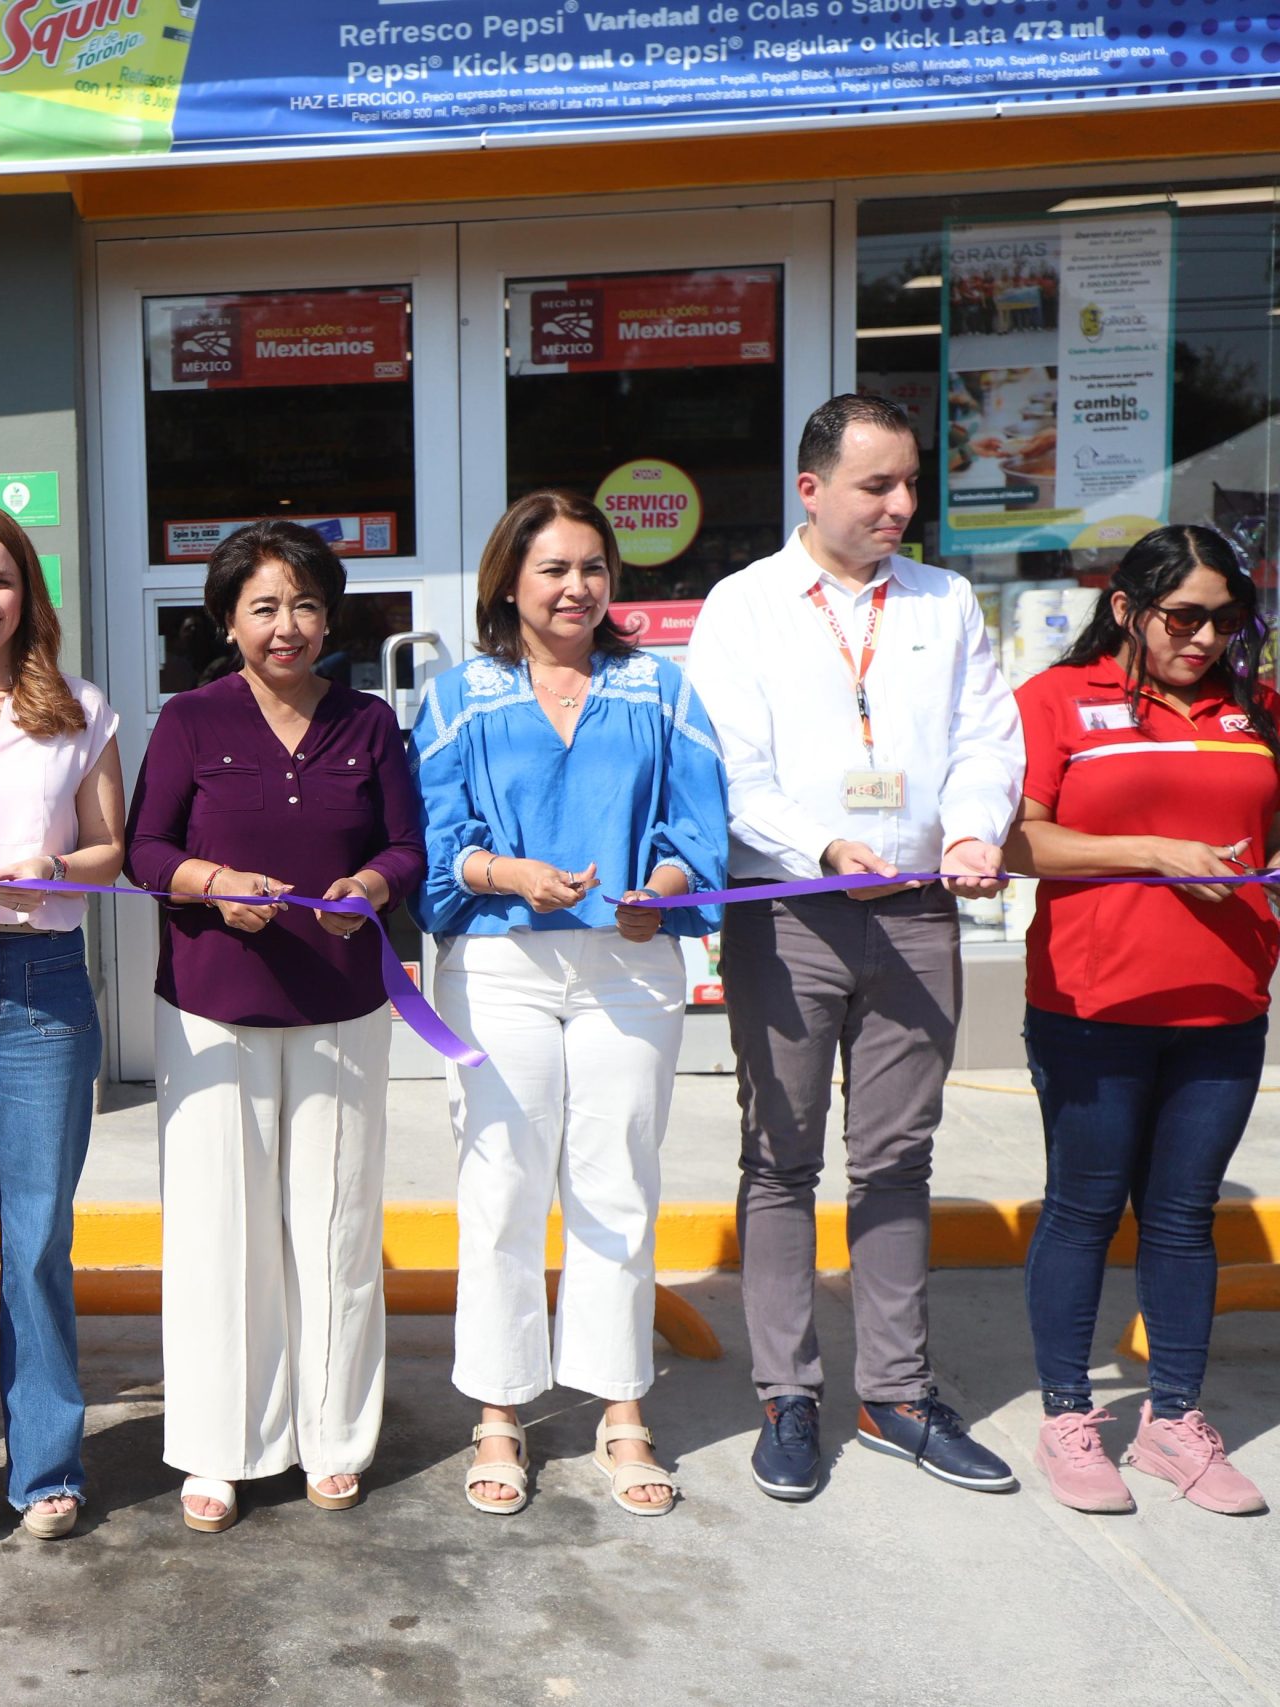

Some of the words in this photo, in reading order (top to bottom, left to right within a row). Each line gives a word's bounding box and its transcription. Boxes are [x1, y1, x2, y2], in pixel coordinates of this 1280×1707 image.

[339, 20, 472, 48] Refresco
[584, 5, 701, 32] Variedad
[708, 3, 739, 24] de
[747, 0, 819, 22] Colas
[827, 0, 843, 16] o
[76, 33, 140, 69] Toronja
[453, 50, 519, 78] Kick
[524, 52, 574, 74] 500
[579, 48, 615, 71] ml
[619, 52, 635, 68] o
[753, 35, 852, 62] Regular
[860, 36, 876, 51] o
[885, 27, 941, 50] Kick
[949, 25, 1006, 47] Lata
[1014, 20, 1064, 42] 473
[1070, 16, 1105, 38] ml
[120, 66, 166, 88] Refresco
[289, 95, 324, 111] HAZ
[327, 90, 420, 109] EJERCICIO.
[422, 91, 454, 103] Precio
[455, 88, 508, 103] expresado
[509, 89, 523, 98] en
[524, 86, 565, 97] moneda
[612, 80, 651, 93] Marcas
[835, 64, 889, 79] Manzanita
[1050, 56, 1056, 64] y
[1059, 50, 1091, 64] Squirt
[75, 79, 101, 94] con
[352, 110, 380, 123] Pepsi
[413, 107, 433, 119] 500
[489, 105, 497, 114] o
[498, 101, 527, 115] Pepsi
[560, 98, 582, 110] Lata
[584, 97, 604, 109] 473
[623, 95, 642, 107] Las
[644, 93, 693, 107] imágenes
[695, 89, 748, 102] mostradas
[749, 88, 769, 98] son
[771, 86, 784, 97] de
[841, 79, 870, 94] Pepsi
[893, 77, 924, 90] Globo
[926, 76, 940, 88] de
[942, 73, 973, 86] Pepsi
[975, 72, 995, 84] son
[996, 69, 1034, 82] Marcas
[950, 242, 1048, 265] GRACIAS
[541, 299, 576, 309] HECHO
[580, 298, 594, 307] EN
[181, 317, 214, 327] HECHO
[218, 317, 231, 326] EN
[618, 319, 742, 340] Mexicanos
[256, 338, 375, 359] Mexicanos
[541, 342, 593, 356] MÉXICO
[182, 360, 232, 373] MÉXICO
[376, 364, 402, 375] OXXO
[1074, 394, 1138, 410] cambio
[1073, 413, 1083, 424] x
[1085, 407, 1150, 423] cambio
[605, 494, 688, 511] SERVICIO
[614, 516, 638, 531] 24
[642, 513, 679, 528] HRS
[661, 616, 697, 629] Atenci
[822, 604, 849, 649] OXXO
[862, 607, 877, 648] OXXO
[1224, 717, 1249, 730] OX
